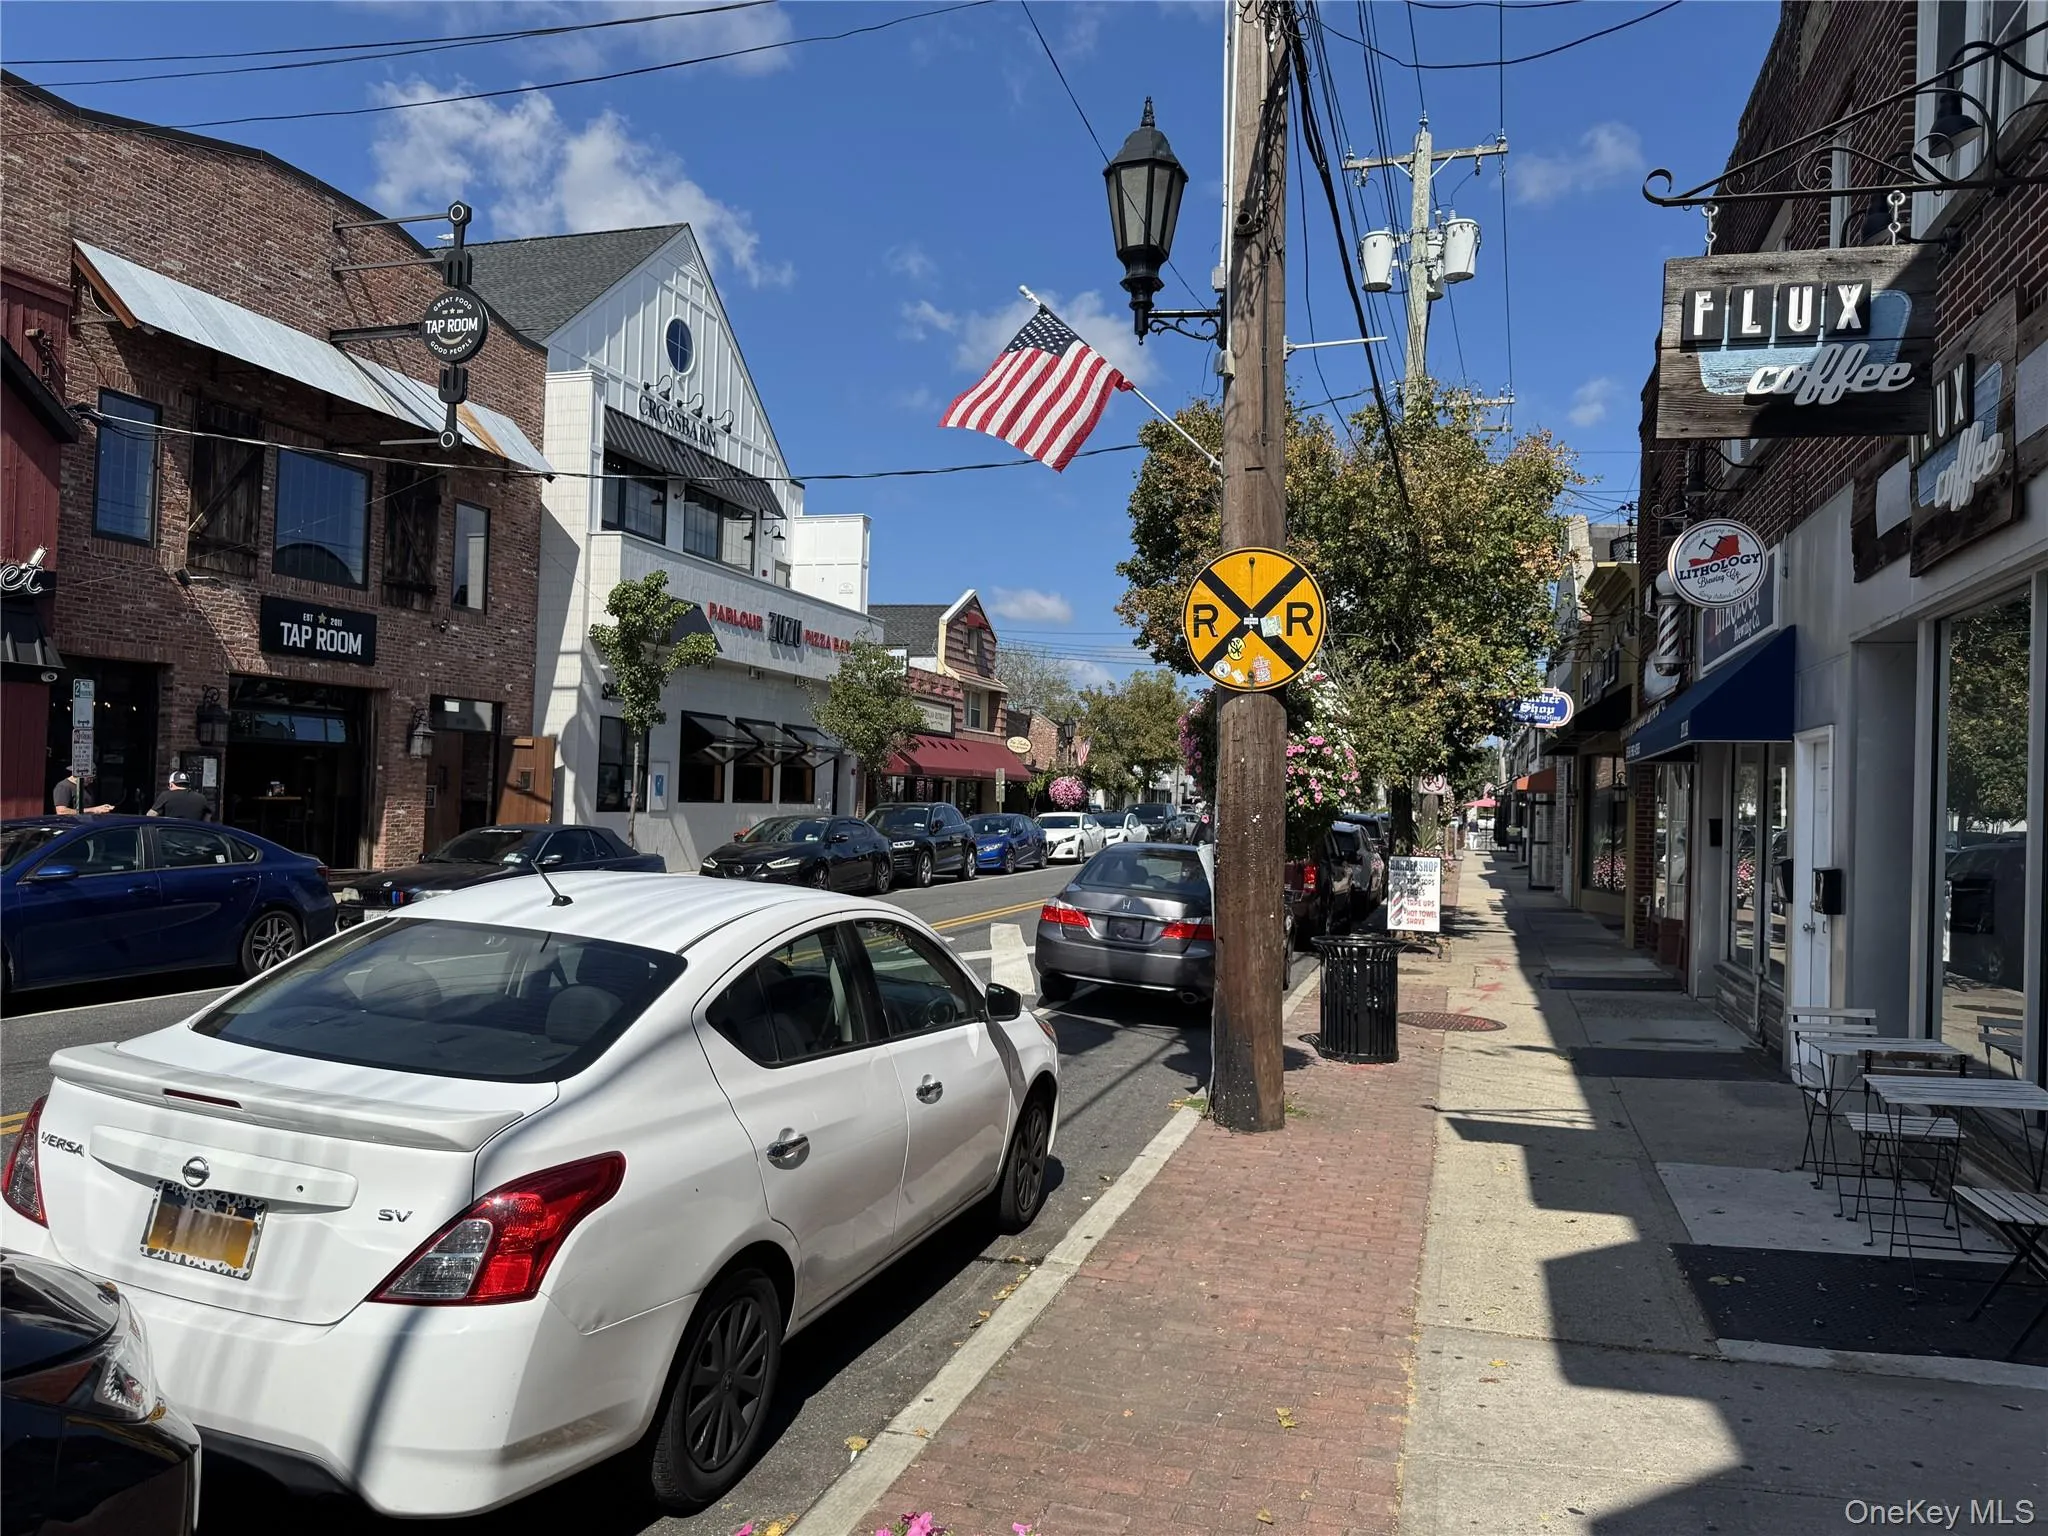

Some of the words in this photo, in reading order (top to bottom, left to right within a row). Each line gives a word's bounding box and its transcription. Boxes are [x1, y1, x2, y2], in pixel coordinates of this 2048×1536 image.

[433, 296, 453, 311] GREAT
[455, 296, 472, 310] FOOD
[1693, 284, 1863, 336] FLUX
[425, 319, 445, 334] TAP
[447, 317, 478, 333] ROOM
[430, 341, 448, 354] GOOD
[449, 338, 473, 355] PEOPLE
[1746, 343, 1915, 406] coffee
[639, 395, 716, 449] CROSSBARN
[1934, 420, 2005, 512] coffee
[1679, 553, 1761, 580] LITHOLOGY
[1697, 573, 1725, 588] Brewing
[303, 613, 314, 622] EST
[707, 601, 763, 633] PARLOUR
[767, 611, 803, 648] ZUZU
[804, 629, 832, 650] PIZZA
[1193, 603, 1219, 638] R
[1286, 602, 1315, 637] R
[280, 621, 312, 648] TAP
[316, 627, 362, 656] ROOM
[1519, 702, 1555, 715] Shop
[41, 1131, 84, 1157] VERSA
[378, 1209, 413, 1222] SV
